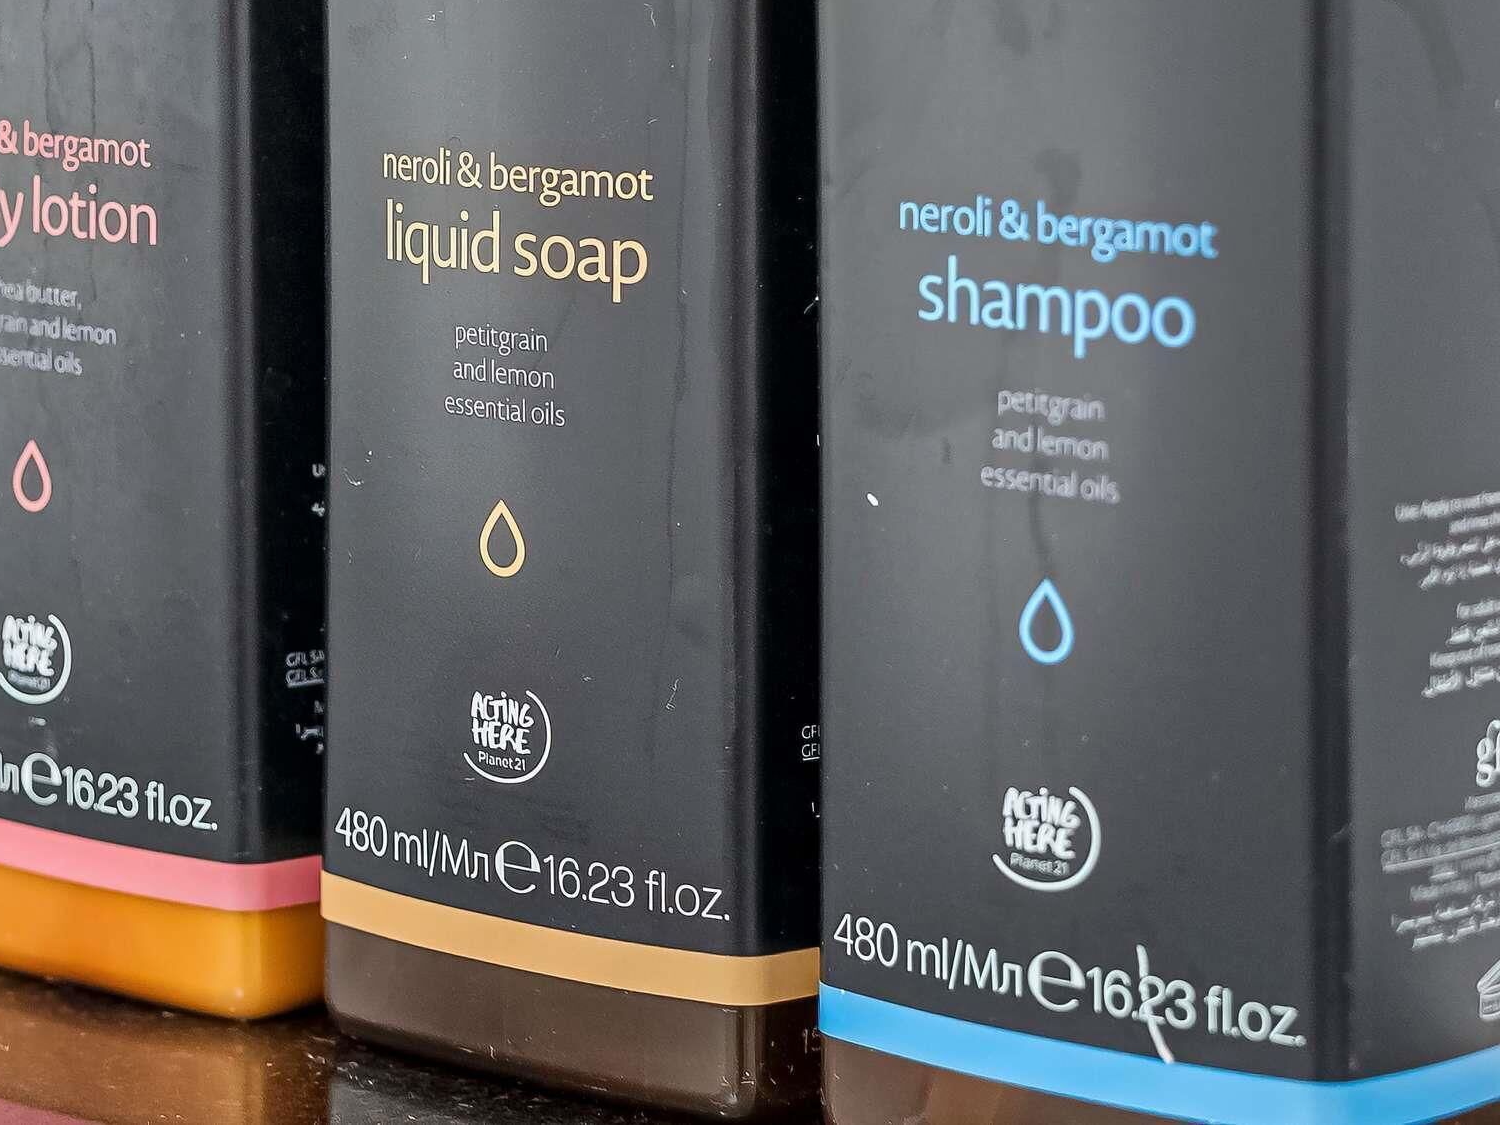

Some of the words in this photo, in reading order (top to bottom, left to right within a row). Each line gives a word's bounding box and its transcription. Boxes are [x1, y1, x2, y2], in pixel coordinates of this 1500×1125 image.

[23, 120, 152, 172] bergamot
[383, 147, 451, 186] neroli
[457, 151, 483, 189] &
[489, 152, 654, 208] bergamot
[32, 174, 158, 246] lotion
[899, 194, 994, 237] neroli
[999, 198, 1030, 242] &
[1036, 200, 1219, 263] bergamot
[386, 198, 501, 285] liquid
[513, 232, 648, 304] soap
[917, 254, 1196, 359] shampoo
[62, 316, 117, 346] lemon
[454, 325, 549, 357] petitgrain
[453, 358, 487, 383] and
[490, 359, 555, 390] lemon
[444, 394, 526, 424] essential
[530, 402, 566, 427] oils
[997, 388, 1106, 426] petitgrain
[991, 425, 1033, 453] and
[1037, 425, 1110, 461] lemon
[1079, 475, 1121, 505] oils
[471, 717, 531, 754] HERE
[478, 750, 514, 770] Planet
[514, 757, 526, 772] 21
[62, 765, 139, 819] 16.23
[144, 780, 218, 832] fl.oz.
[1002, 816, 1077, 860] HERE
[334, 807, 388, 857] 480
[543, 854, 636, 908] 16.23
[644, 870, 731, 922] fl.oz.
[833, 913, 899, 968] 480
[1086, 966, 1198, 1031] 16.23
[1203, 985, 1308, 1048] fl.oz.
